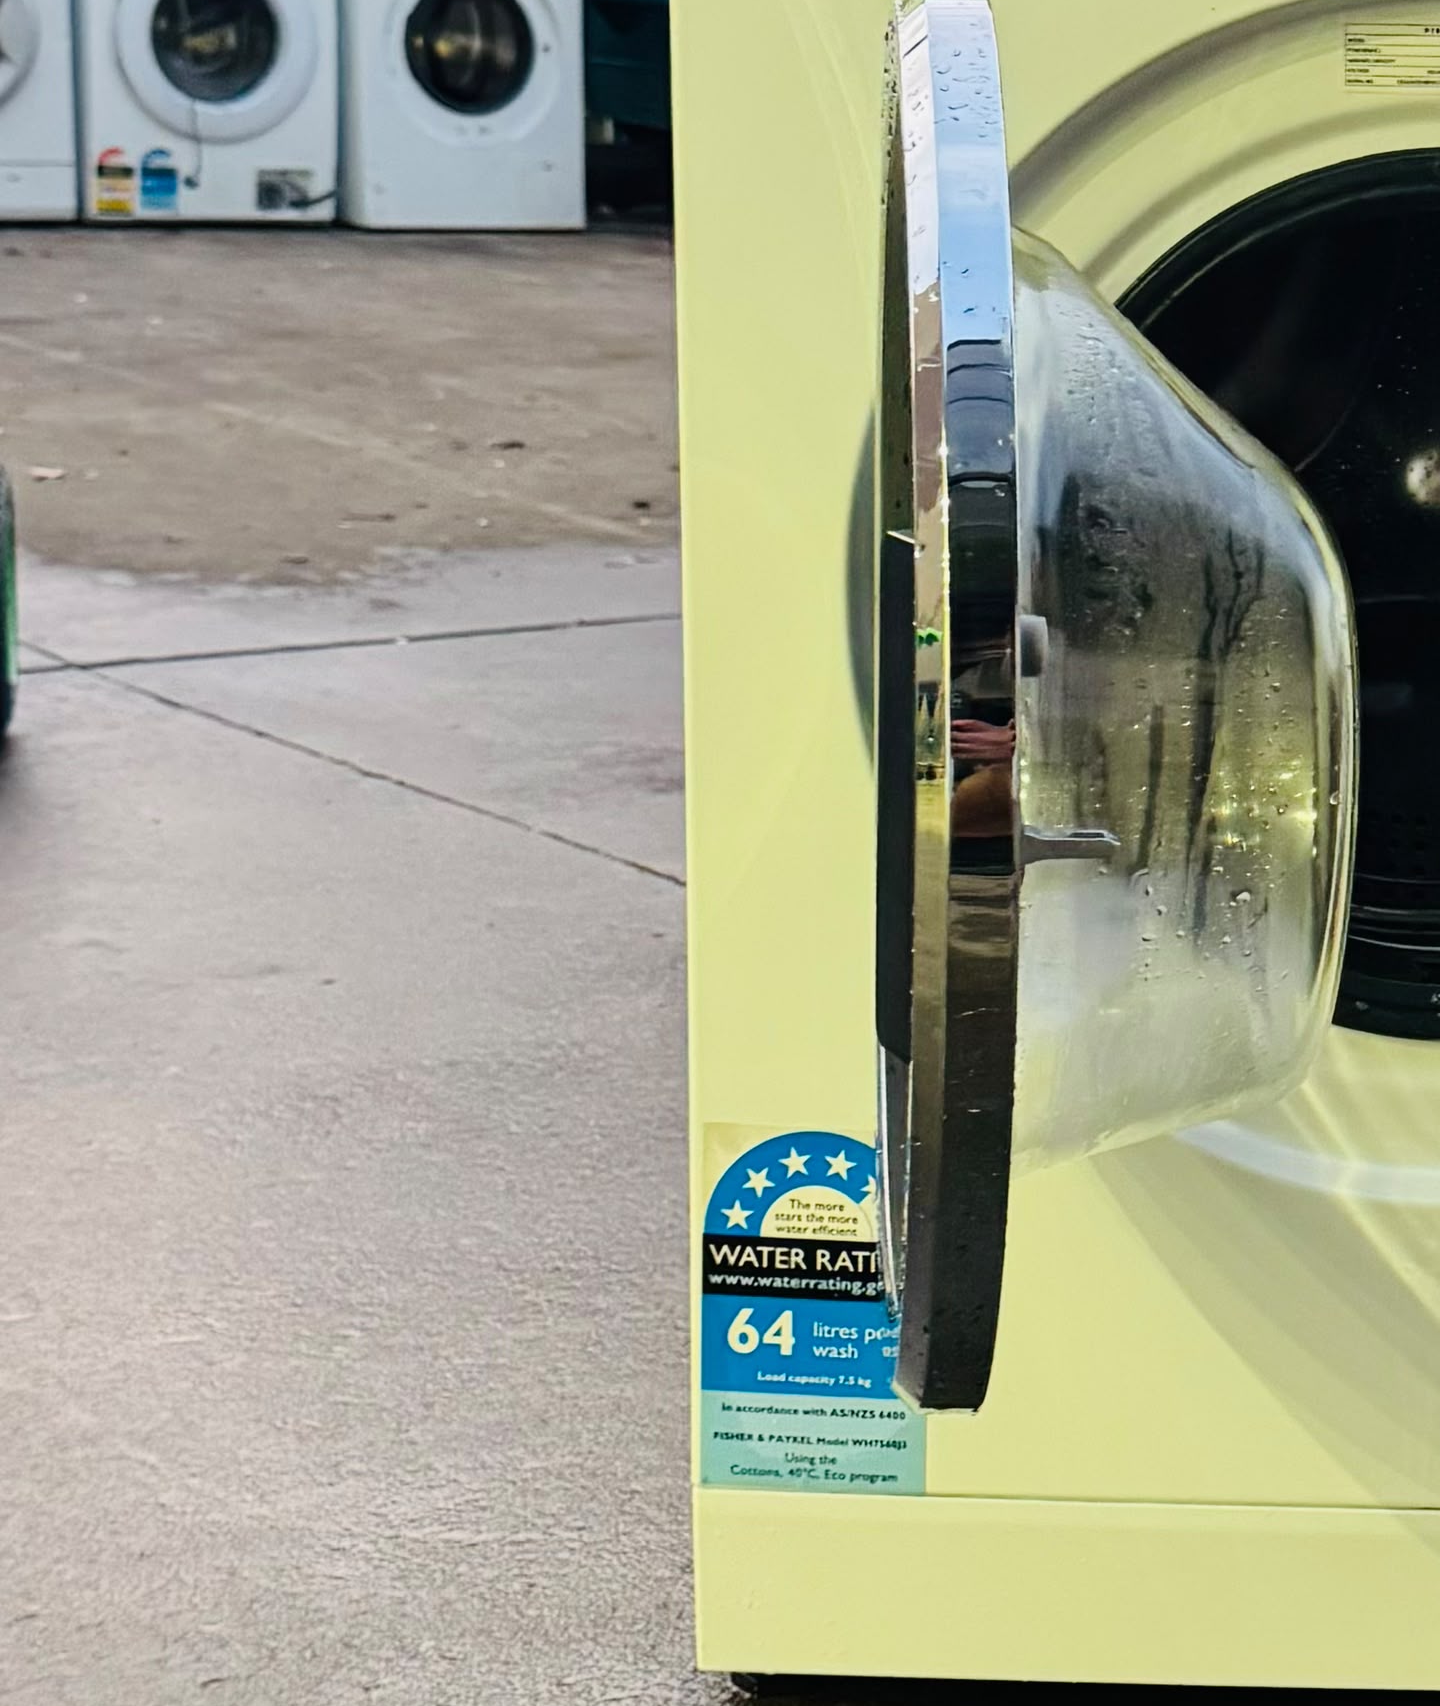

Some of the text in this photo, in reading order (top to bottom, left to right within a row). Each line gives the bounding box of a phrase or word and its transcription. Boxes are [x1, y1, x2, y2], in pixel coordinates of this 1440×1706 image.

[789, 1198, 845, 1212] The more
[775, 1212, 859, 1225] stars the more
[776, 1224, 808, 1235] water
[709, 1244, 880, 1273] WATER RATI
[727, 1307, 797, 1356] 64
[813, 1321, 859, 1340] litres
[812, 1344, 859, 1359] wash
[757, 1370, 873, 1388] Load capacity 7.5 kg
[735, 1405, 799, 1416] accordance
[802, 1408, 828, 1417] with
[713, 1431, 754, 1442] FISHER
[757, 1433, 766, 1443] &
[769, 1433, 812, 1445] PAYKEL
[816, 1437, 850, 1447] Model
[785, 1452, 838, 1466] Using the
[824, 1469, 846, 1480] Eco
[849, 1471, 899, 1484] program
